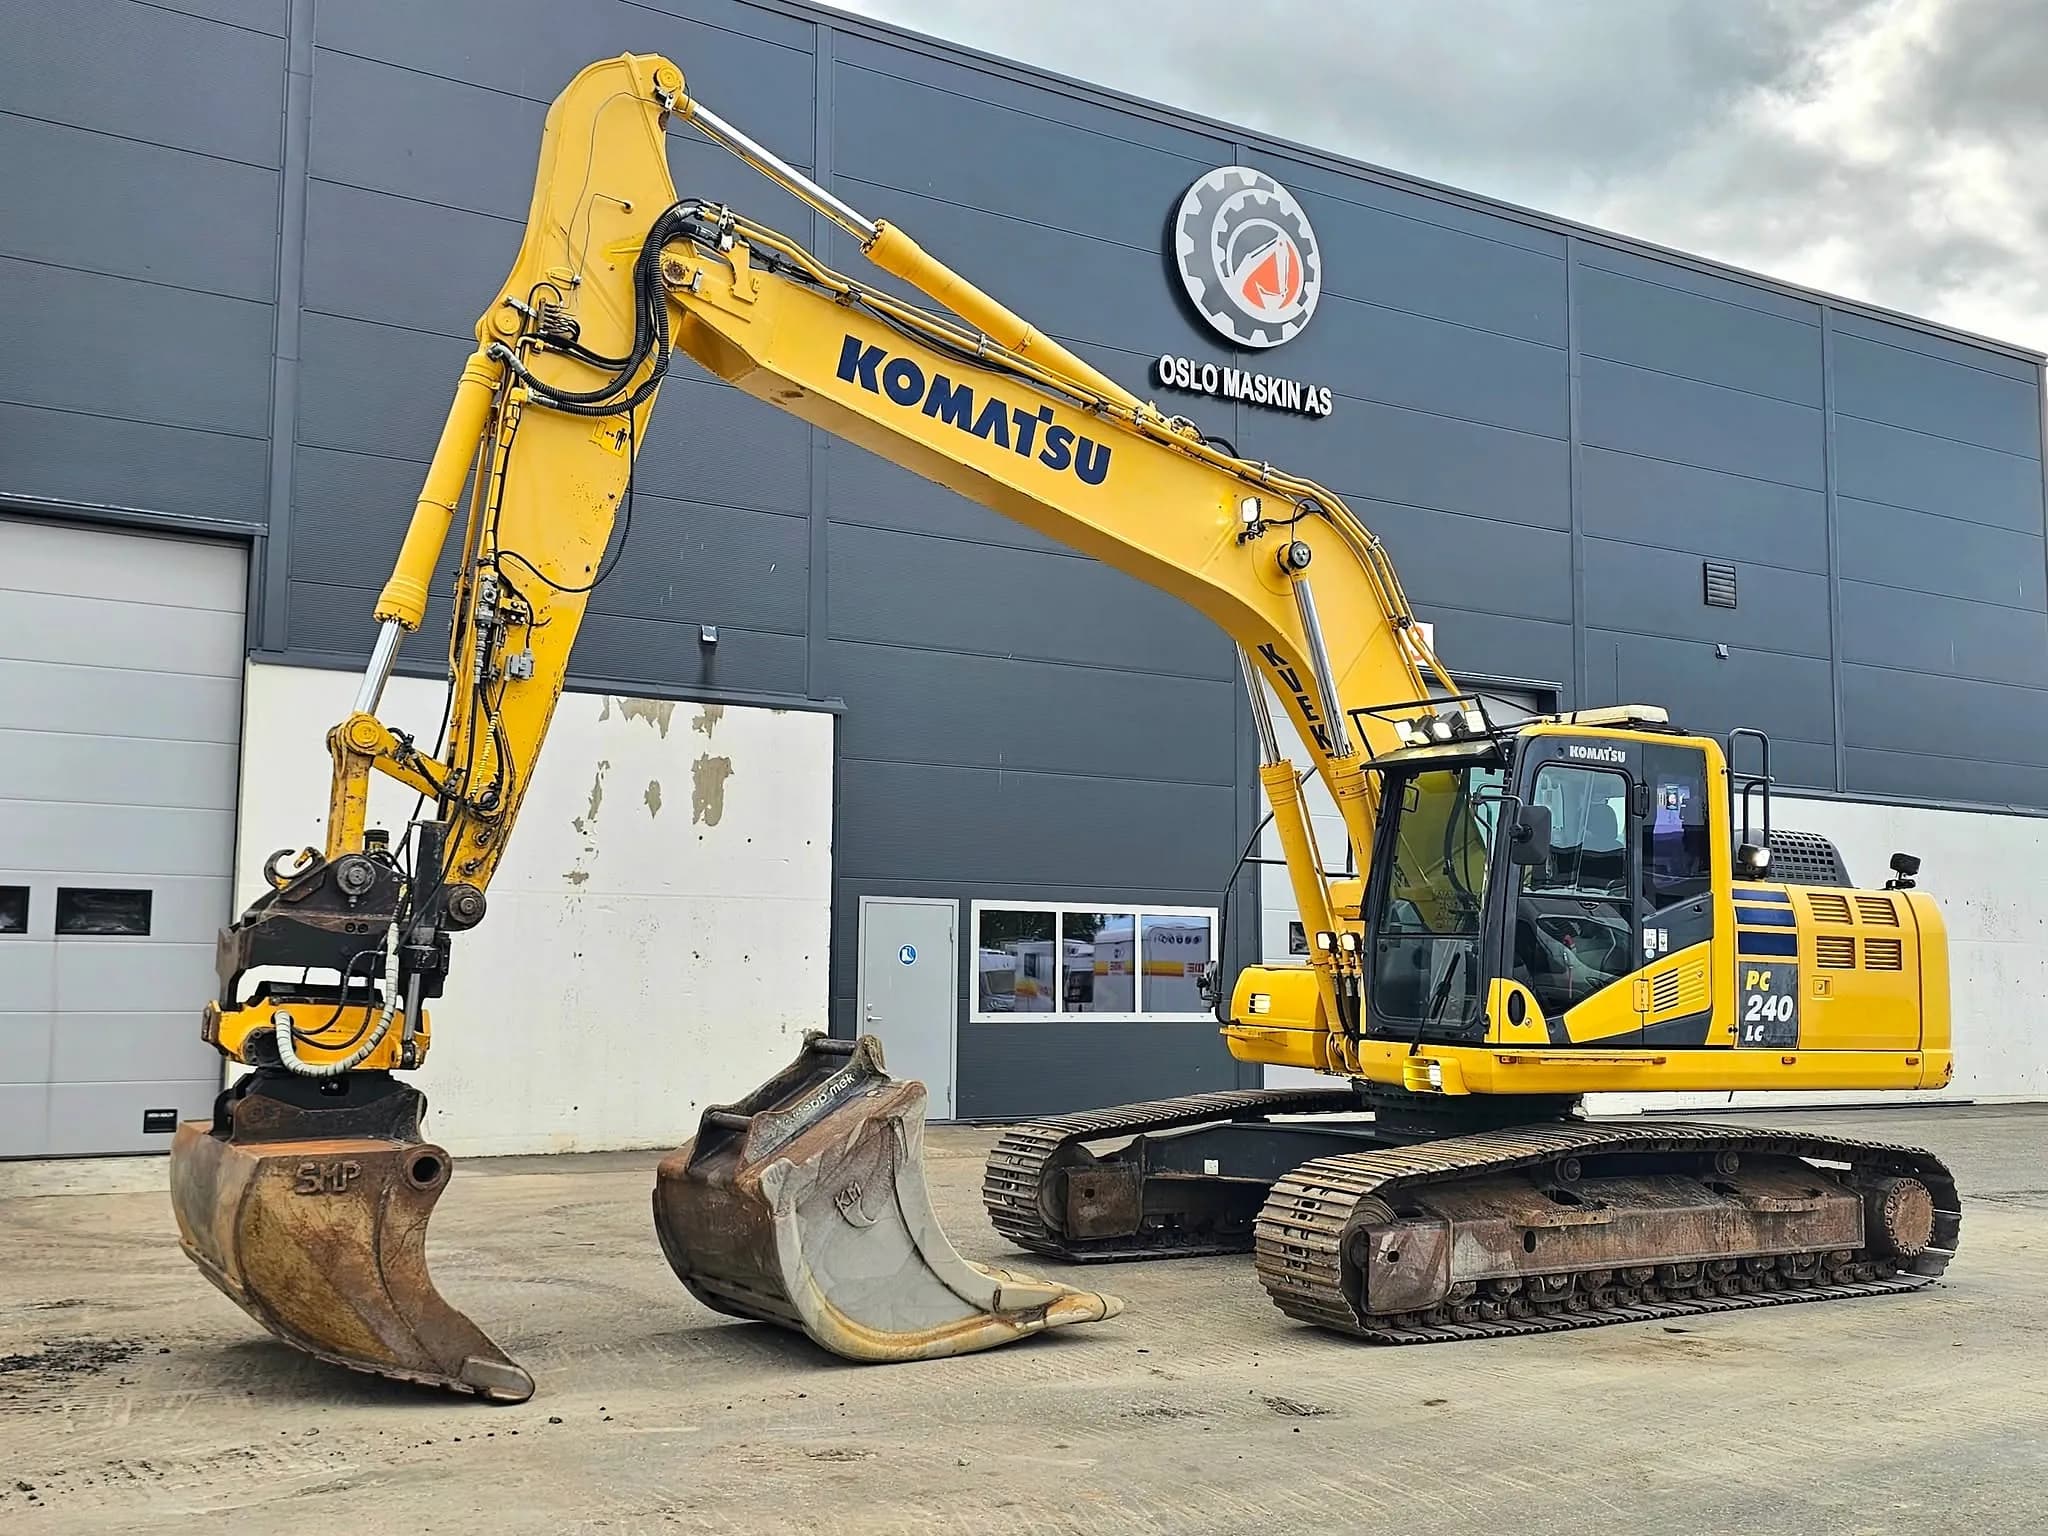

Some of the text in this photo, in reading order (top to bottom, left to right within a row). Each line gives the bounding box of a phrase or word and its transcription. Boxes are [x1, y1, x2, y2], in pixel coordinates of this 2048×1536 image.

[1159, 354, 1333, 416] OSLO MASKIN AS
[836, 334, 1112, 485] KOMATSU
[1257, 643, 1335, 759] KVEK
[1569, 746, 1626, 763] KOMATSU
[1745, 970, 1772, 991] PC
[1744, 994, 1794, 1022] 240
[1744, 1024, 1765, 1042] LC
[295, 1161, 361, 1194] SMP
